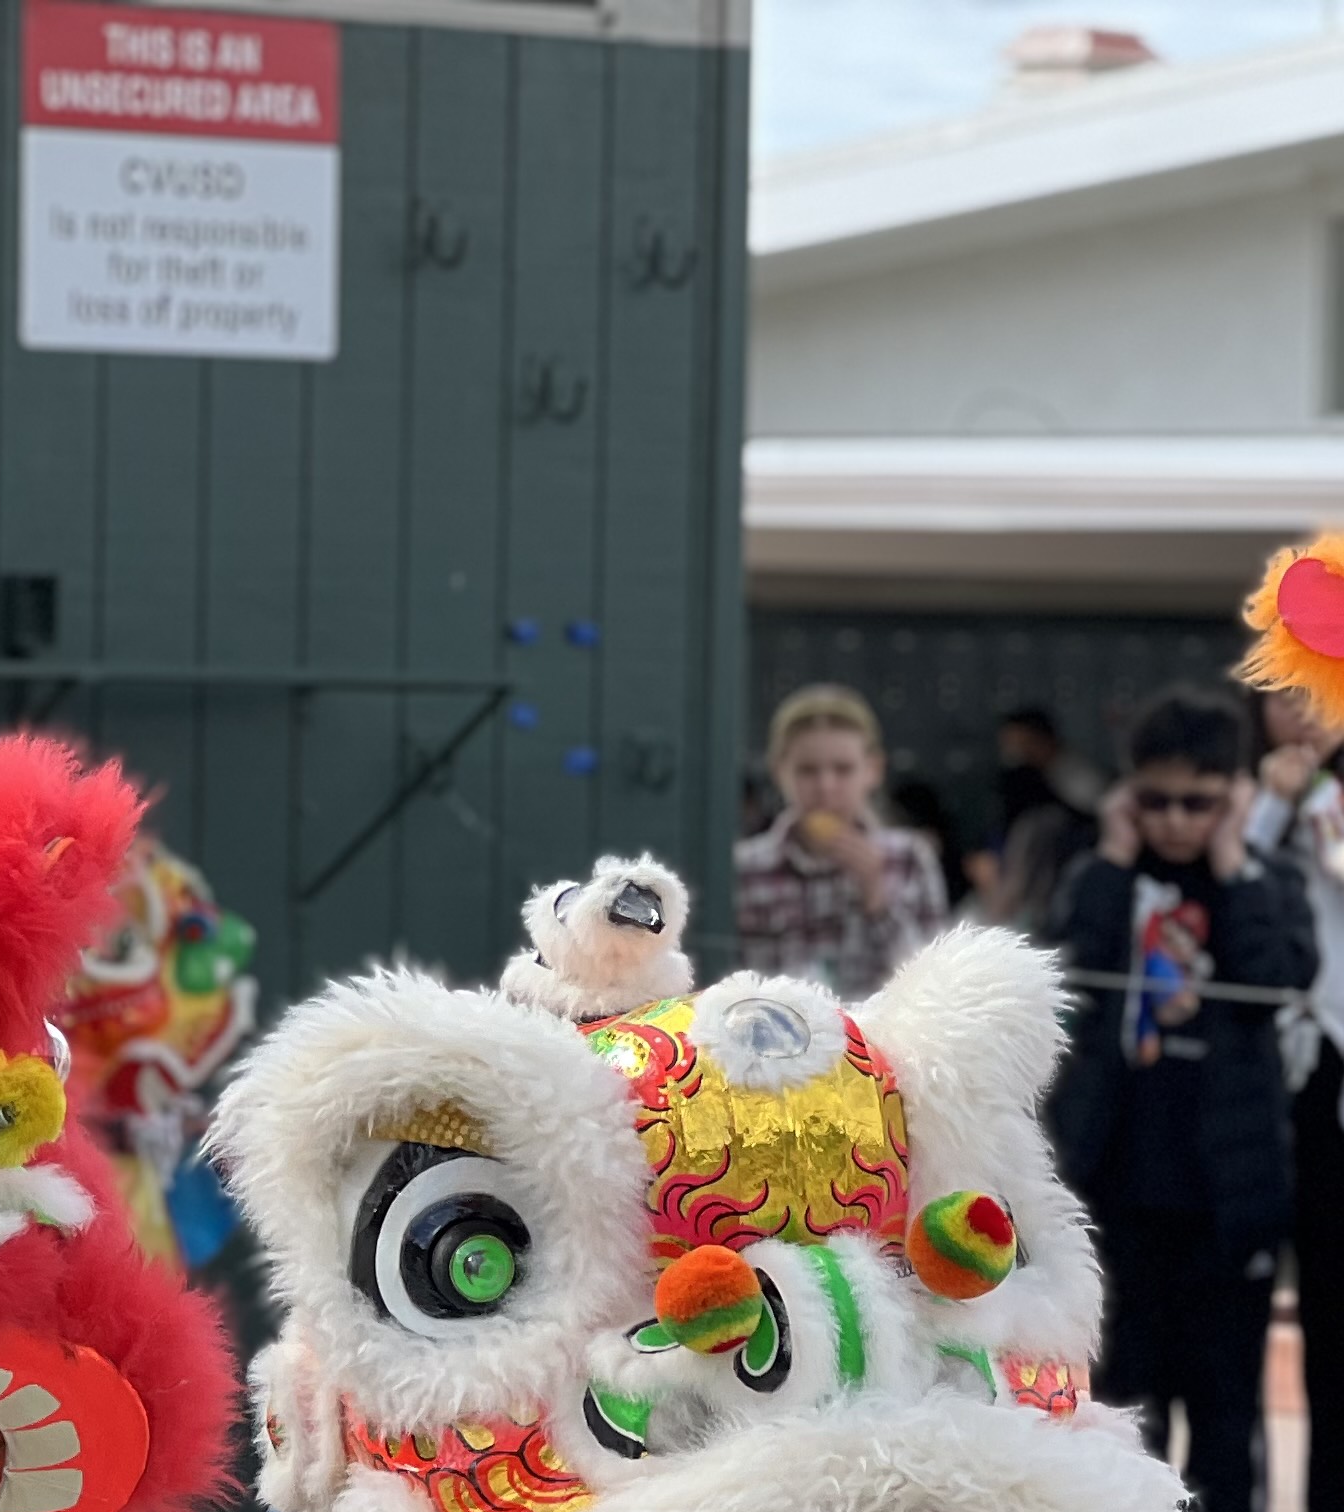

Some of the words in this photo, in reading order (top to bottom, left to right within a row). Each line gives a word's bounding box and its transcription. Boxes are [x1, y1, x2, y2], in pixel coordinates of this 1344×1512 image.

[104, 21, 176, 69] THIS
[178, 28, 212, 71] IS
[215, 34, 263, 74] AN
[40, 69, 233, 121] UNSECURED
[235, 82, 321, 127] AREA
[119, 157, 246, 201] CVUSD
[85, 213, 137, 245] not
[142, 216, 311, 254] responsible
[107, 251, 150, 286] for
[157, 257, 229, 290] theft
[232, 263, 264, 290] or
[67, 289, 130, 326] loss
[138, 291, 174, 327] of
[177, 300, 301, 341] property
